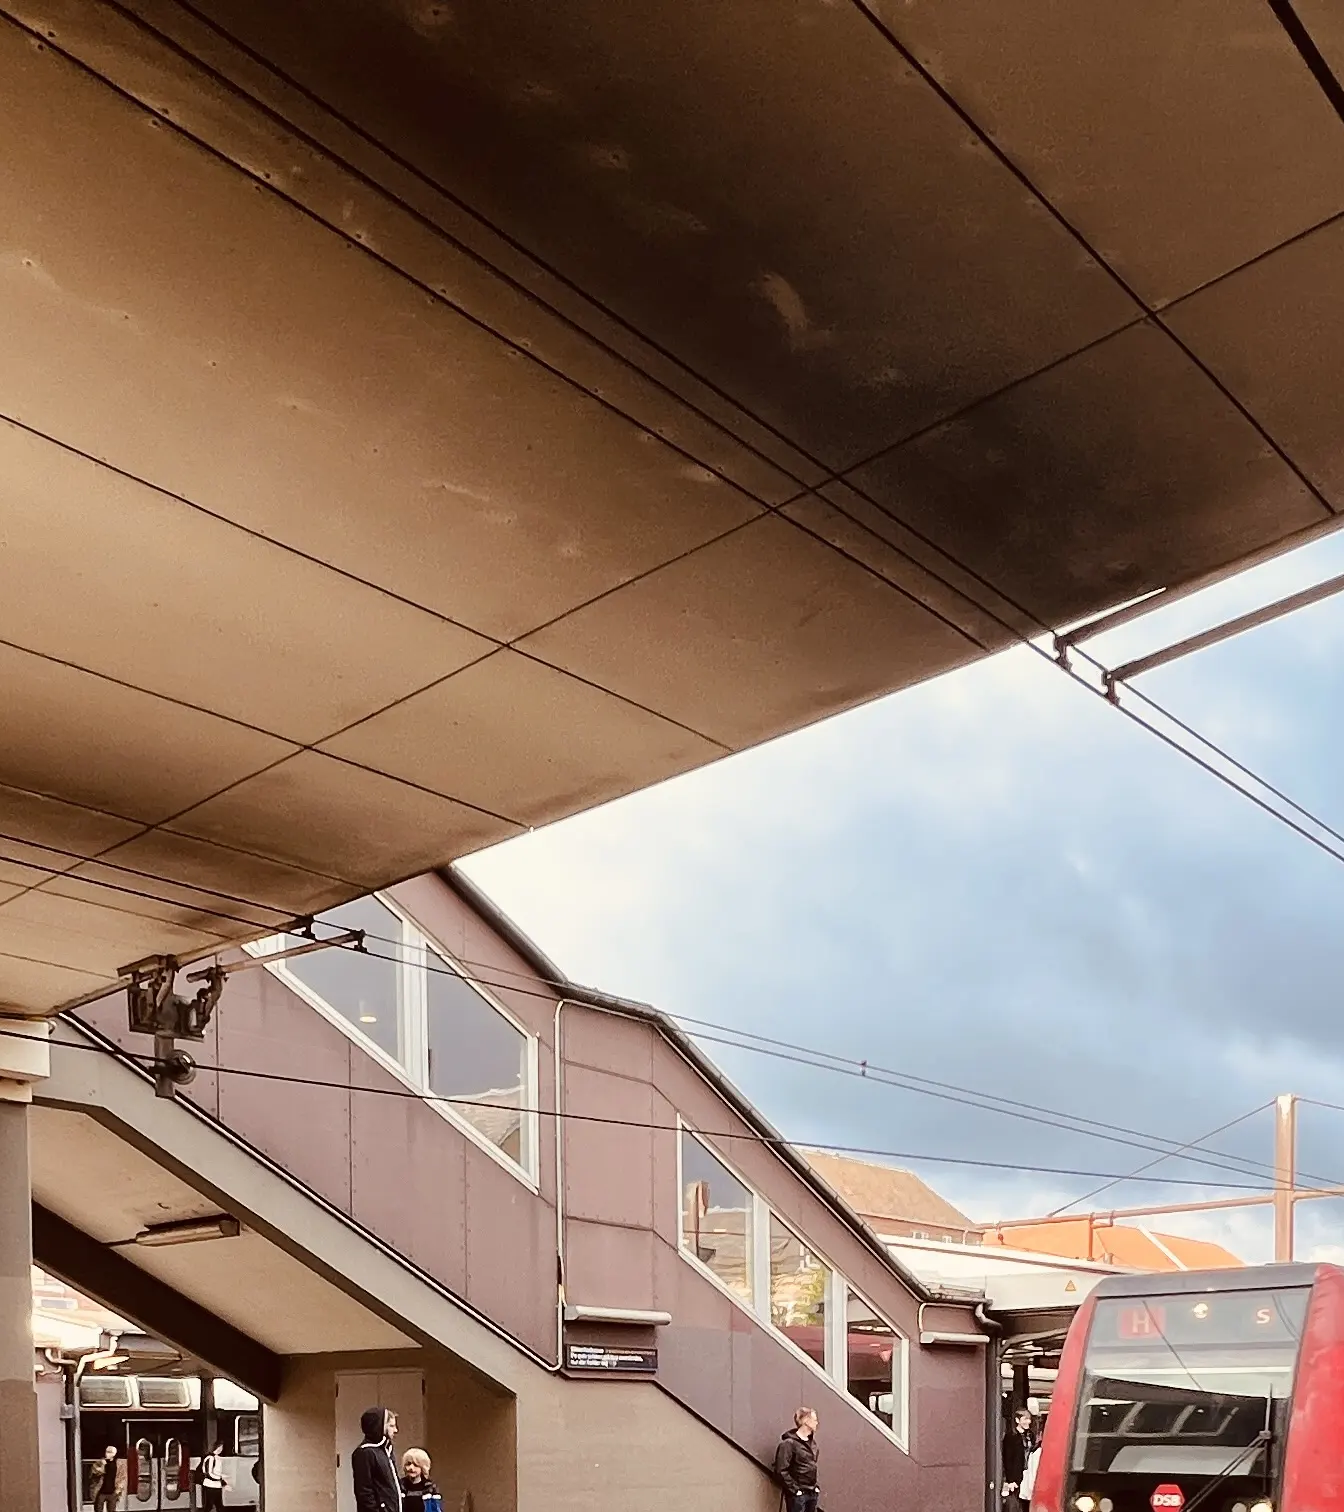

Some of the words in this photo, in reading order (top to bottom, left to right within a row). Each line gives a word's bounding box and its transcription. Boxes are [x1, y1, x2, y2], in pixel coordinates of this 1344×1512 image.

[1132, 1314, 1150, 1333] H
[1256, 1309, 1271, 1324] S
[1153, 1494, 1181, 1506] DSB
